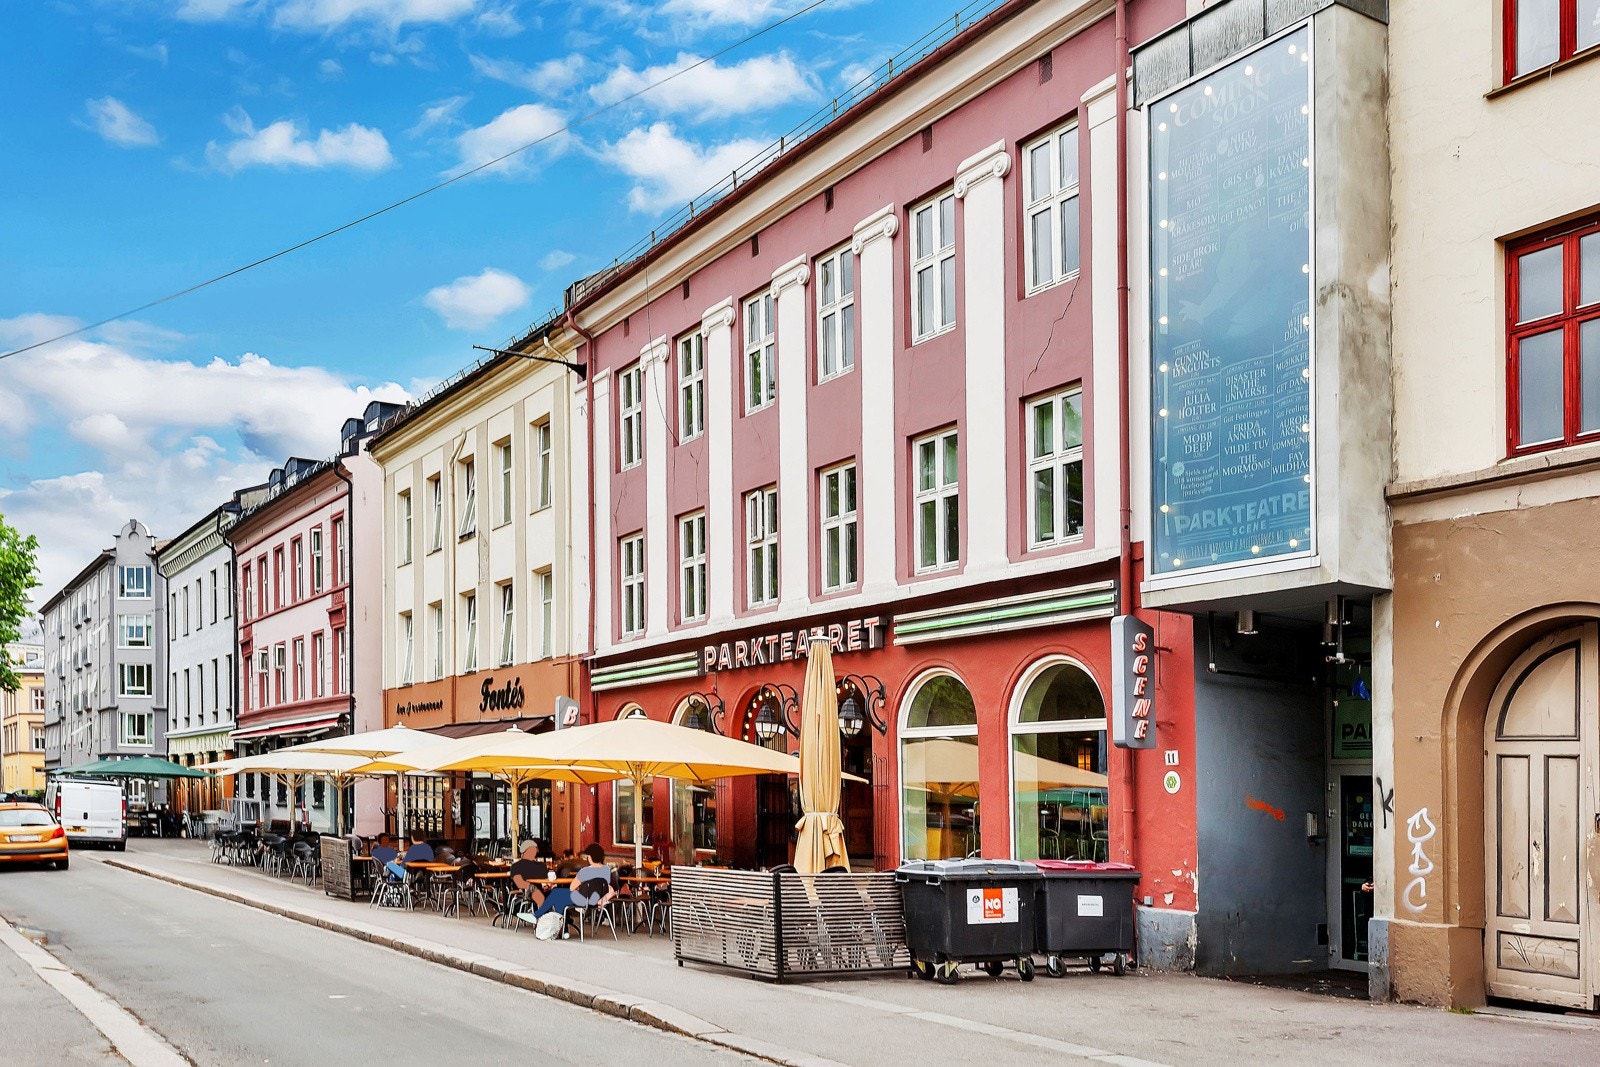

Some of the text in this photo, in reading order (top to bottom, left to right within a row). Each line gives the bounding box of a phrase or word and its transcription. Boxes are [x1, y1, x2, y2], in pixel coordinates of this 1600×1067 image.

[1175, 62, 1270, 127] COMING
[1212, 90, 1269, 128] SOON
[1174, 349, 1210, 368] CUNNIN
[1225, 368, 1267, 387] DISASTER
[1230, 377, 1260, 393] IN THE
[1184, 392, 1211, 407] JULIA
[1225, 384, 1268, 403] UNIVERSE
[1179, 402, 1217, 420] HOLTER
[1233, 420, 1261, 433] FRIDA
[1183, 431, 1213, 445] MOBB
[1184, 440, 1212, 454] DEEP
[1224, 438, 1270, 456] VILDE TUV
[1239, 453, 1257, 465] THE
[1174, 489, 1309, 534] PARKTEATRE
[1232, 519, 1267, 537] SCENE
[478, 676, 525, 713] Fontés
[1132, 632, 1151, 740] SCENE
[562, 705, 579, 726] B
